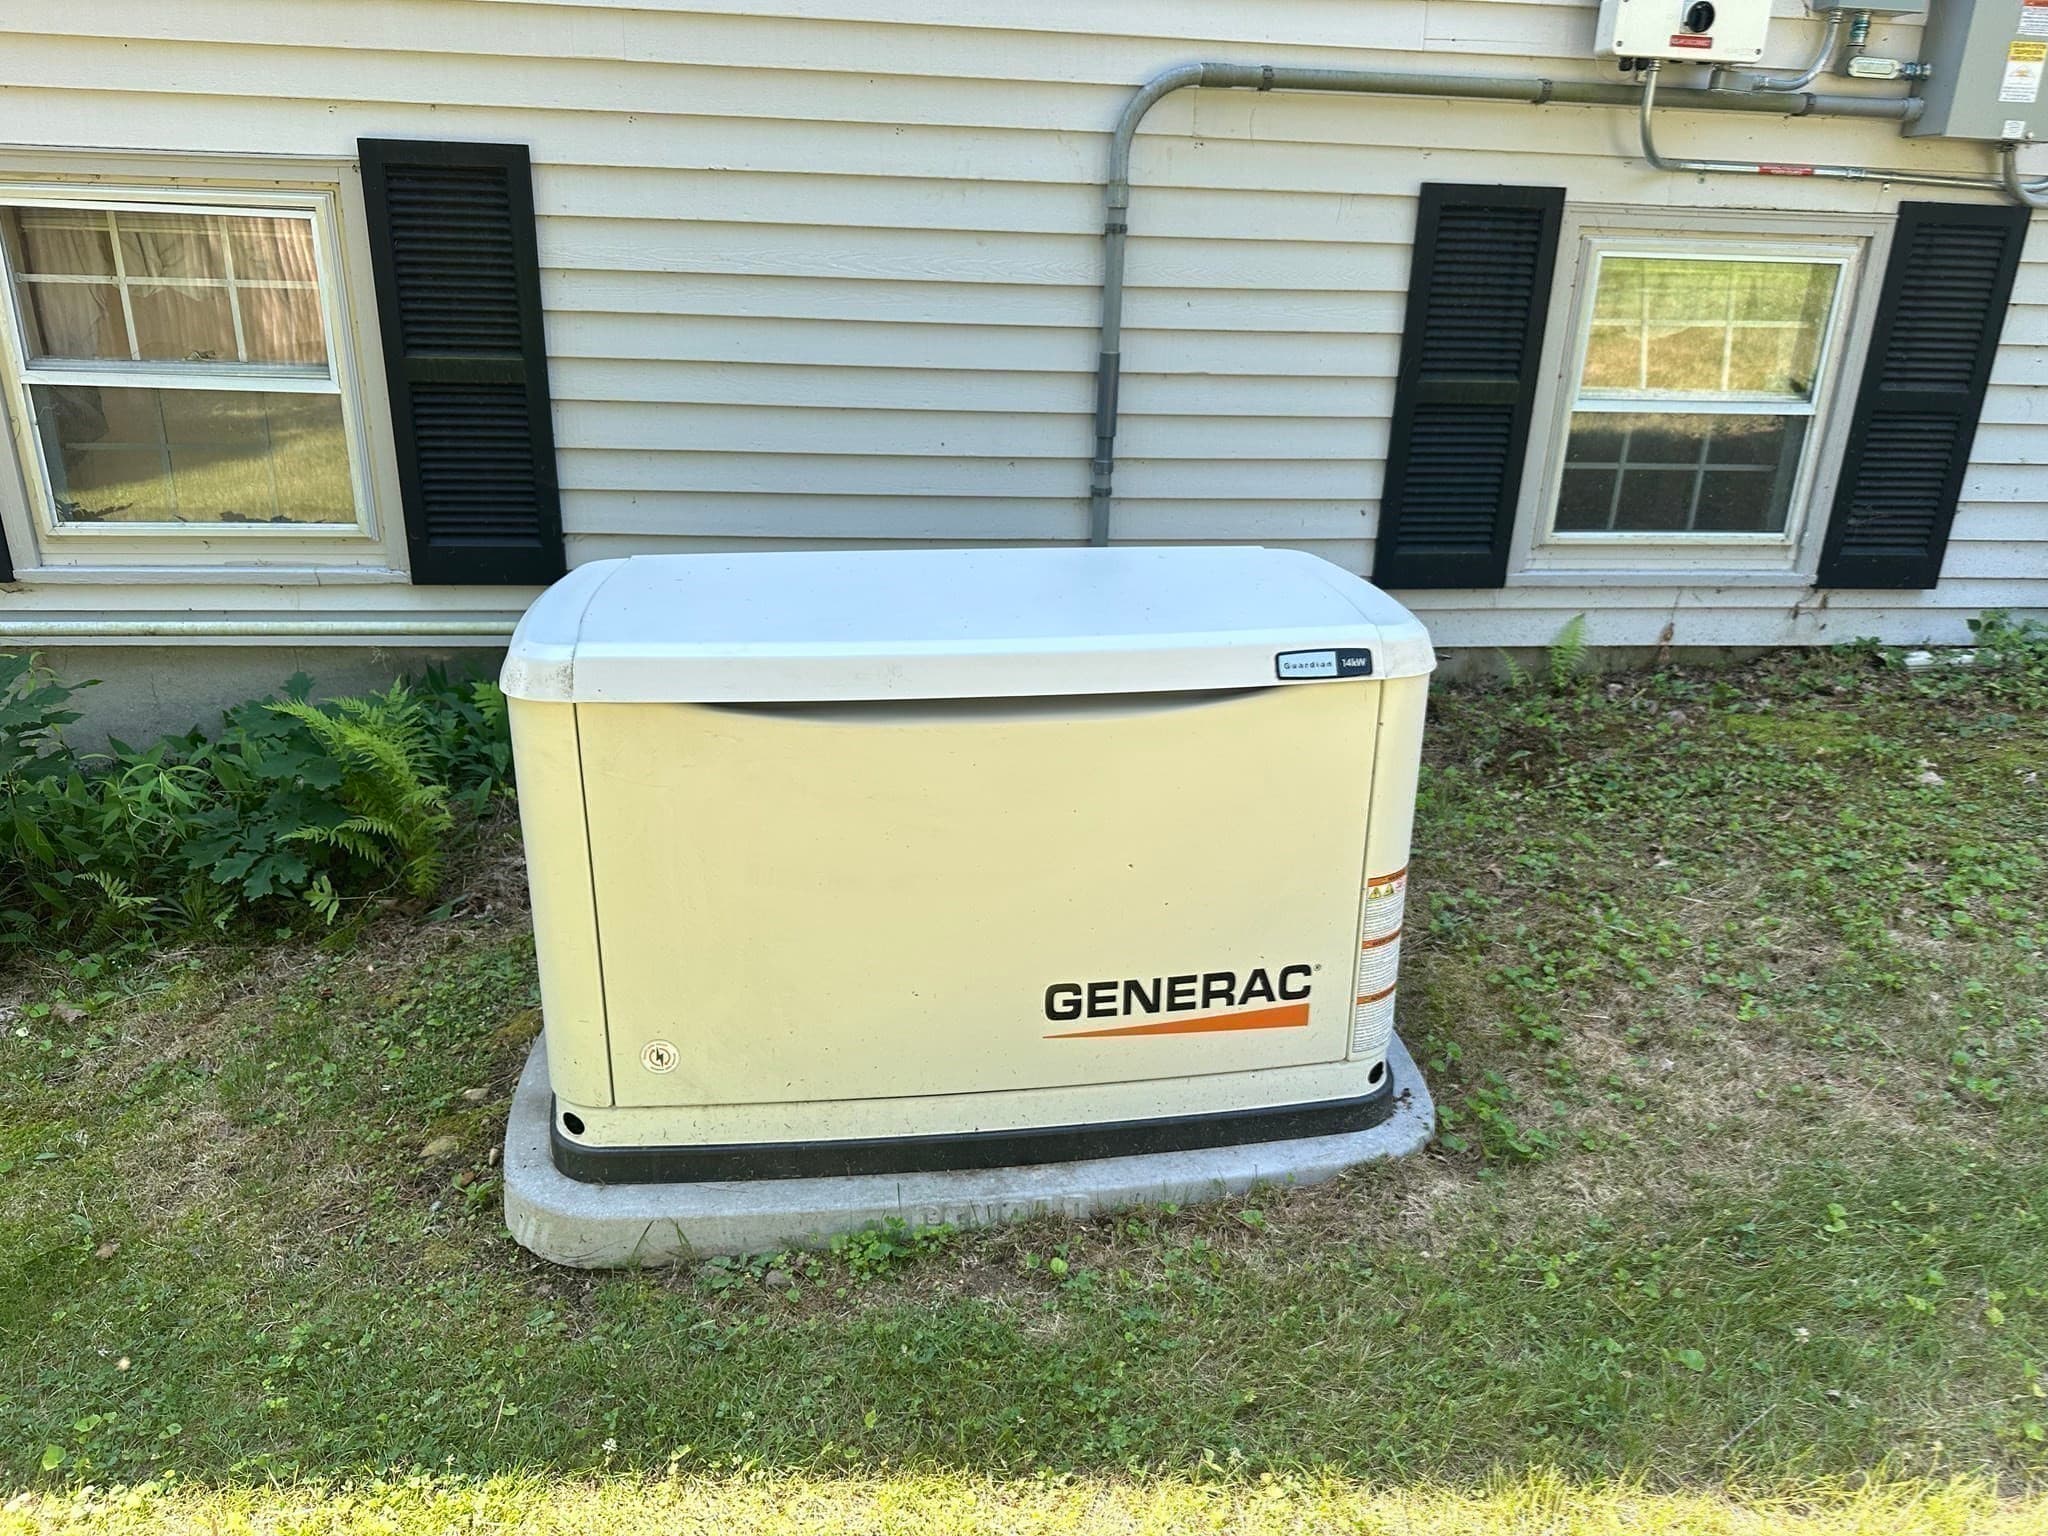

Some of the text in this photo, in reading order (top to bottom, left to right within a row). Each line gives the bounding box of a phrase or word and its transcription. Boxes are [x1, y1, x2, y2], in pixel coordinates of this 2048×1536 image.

[1283, 657, 1367, 670] Guardian 14kW
[1044, 964, 1312, 1021] GENERAC
